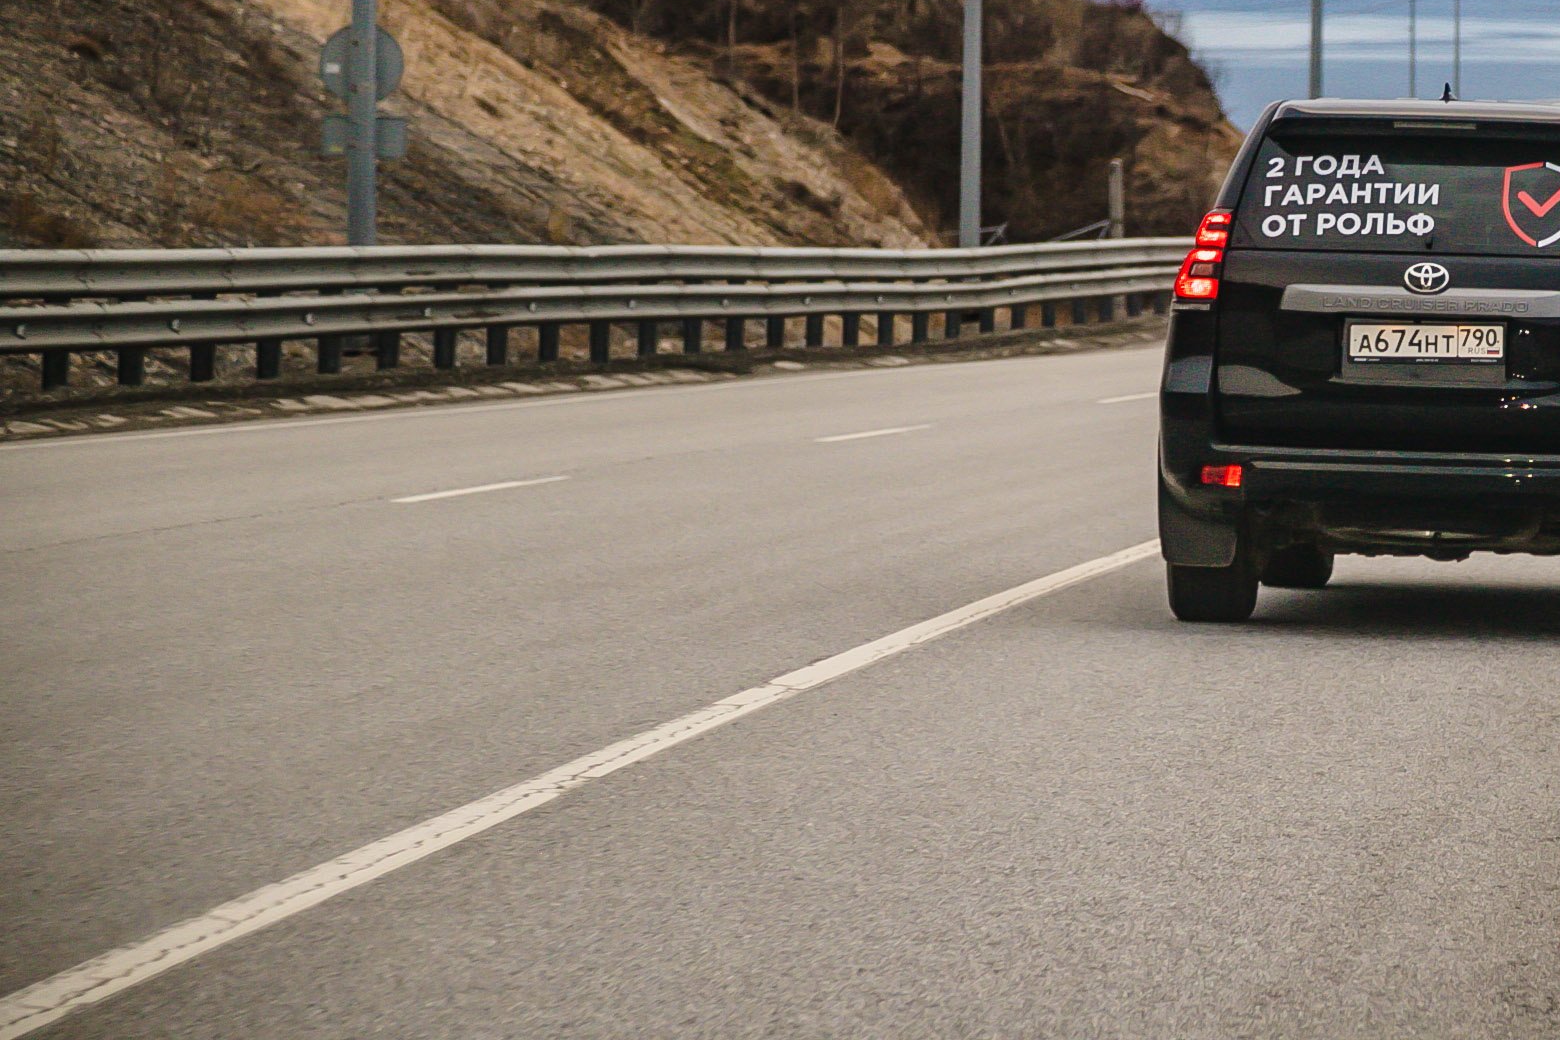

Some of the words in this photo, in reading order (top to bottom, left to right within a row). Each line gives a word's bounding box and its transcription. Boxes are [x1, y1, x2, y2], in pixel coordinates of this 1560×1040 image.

[1266, 157, 1285, 177] 2
[1294, 154, 1385, 178] ГОДА
[1264, 183, 1440, 207] ГАРАНТИИ
[1261, 213, 1307, 238] ОТ
[1316, 212, 1435, 236] РОЛЬФ
[1322, 296, 1373, 309] LAND
[1375, 298, 1459, 311] CRUISER
[1463, 300, 1530, 314] PRADO
[1459, 328, 1498, 347] 790
[1467, 347, 1486, 355] RUS
